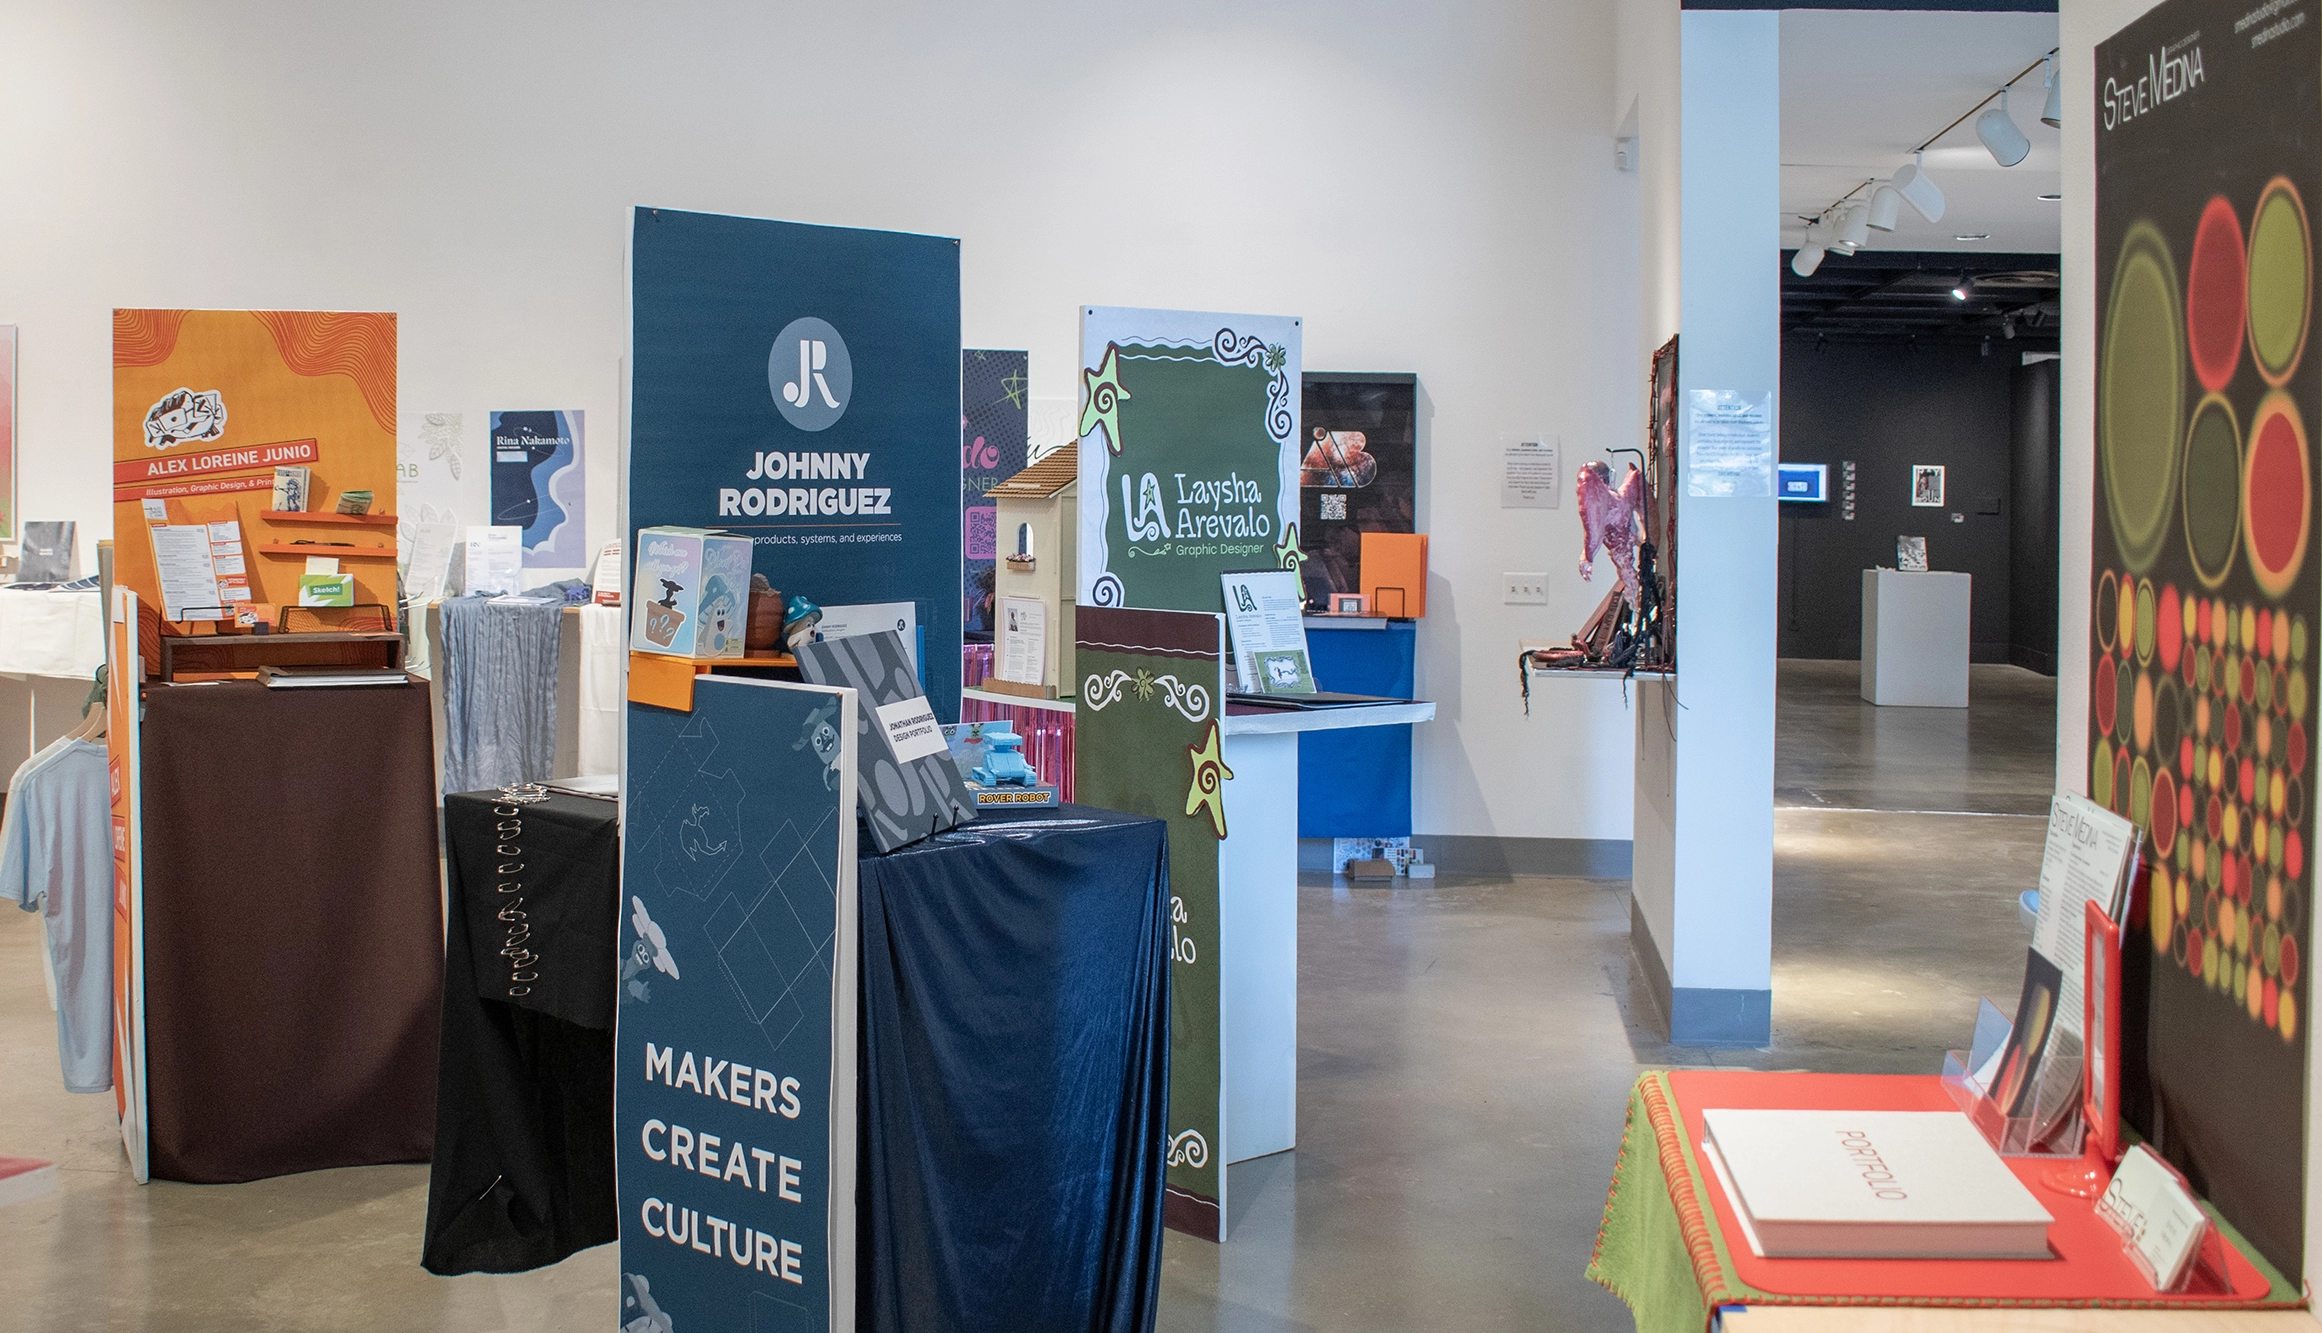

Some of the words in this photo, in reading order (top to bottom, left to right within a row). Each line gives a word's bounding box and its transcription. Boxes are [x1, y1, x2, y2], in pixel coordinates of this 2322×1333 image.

[2104, 77, 2148, 131] STEVE
[496, 435, 519, 446] Rina
[521, 435, 571, 446] Nakamoto
[147, 459, 188, 476] ALEX
[192, 450, 259, 470] LOREINE
[262, 444, 312, 463] JUNIO
[746, 451, 871, 480] JOHNNY
[146, 485, 189, 496] Illustration,
[190, 482, 219, 493] Graphic
[220, 480, 247, 490] Design,
[249, 479, 255, 487] &
[718, 487, 892, 516] RODRIGUEZ
[1174, 471, 1262, 512] Laysha
[1175, 506, 1270, 539] Arevalo
[754, 534, 799, 547] products,
[800, 533, 838, 545] systems,
[839, 532, 855, 543] and
[856, 531, 903, 544] experiences
[1176, 543, 1218, 558] Graphic
[1220, 542, 1265, 557] Designer
[313, 586, 341, 594] Sketch!
[889, 719, 912, 731] JONATHAN
[910, 712, 935, 725] RODRIGUEZ
[893, 731, 911, 743] DESIGN
[909, 725, 933, 737] PORTFOLIO
[979, 793, 1013, 803] ROVER
[1014, 792, 1050, 802] ROBOT
[645, 1042, 801, 1119] MAKERS
[641, 1118, 802, 1203] CREATE
[1835, 1130, 1908, 1200] PORTFOLIO
[641, 1196, 803, 1285] CULTURE
